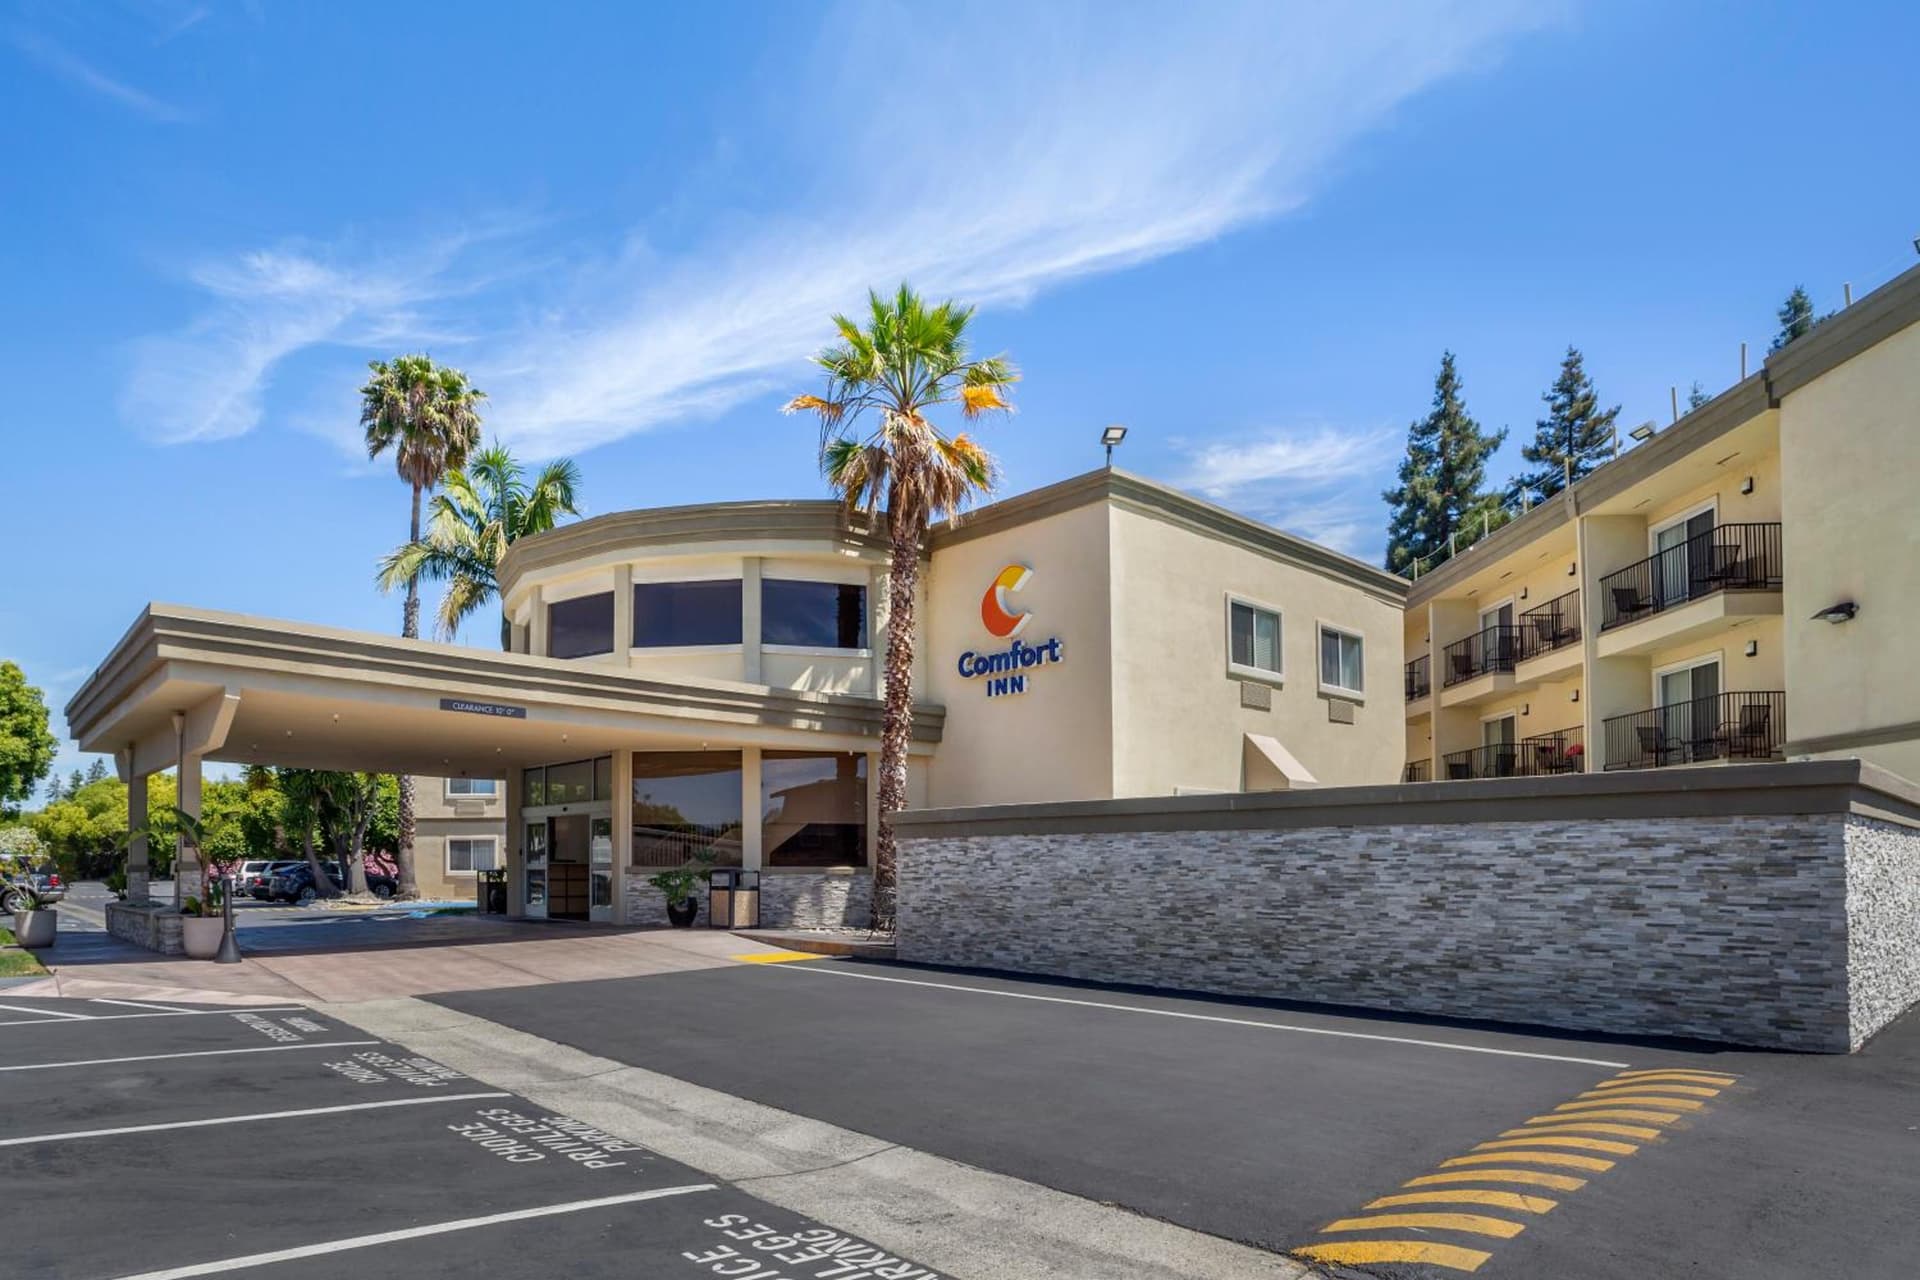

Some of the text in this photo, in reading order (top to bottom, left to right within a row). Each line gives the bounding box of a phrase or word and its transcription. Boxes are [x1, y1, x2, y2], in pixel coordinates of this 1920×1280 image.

[958, 637, 1063, 678] Comfort
[987, 675, 1029, 697] INN
[452, 702, 494, 714] CLEARANCE
[447, 1121, 546, 1163] CHOICE
[475, 1108, 628, 1169] PRIVILEGES
[540, 1116, 644, 1153] PARKING
[681, 1244, 792, 1280] ICE
